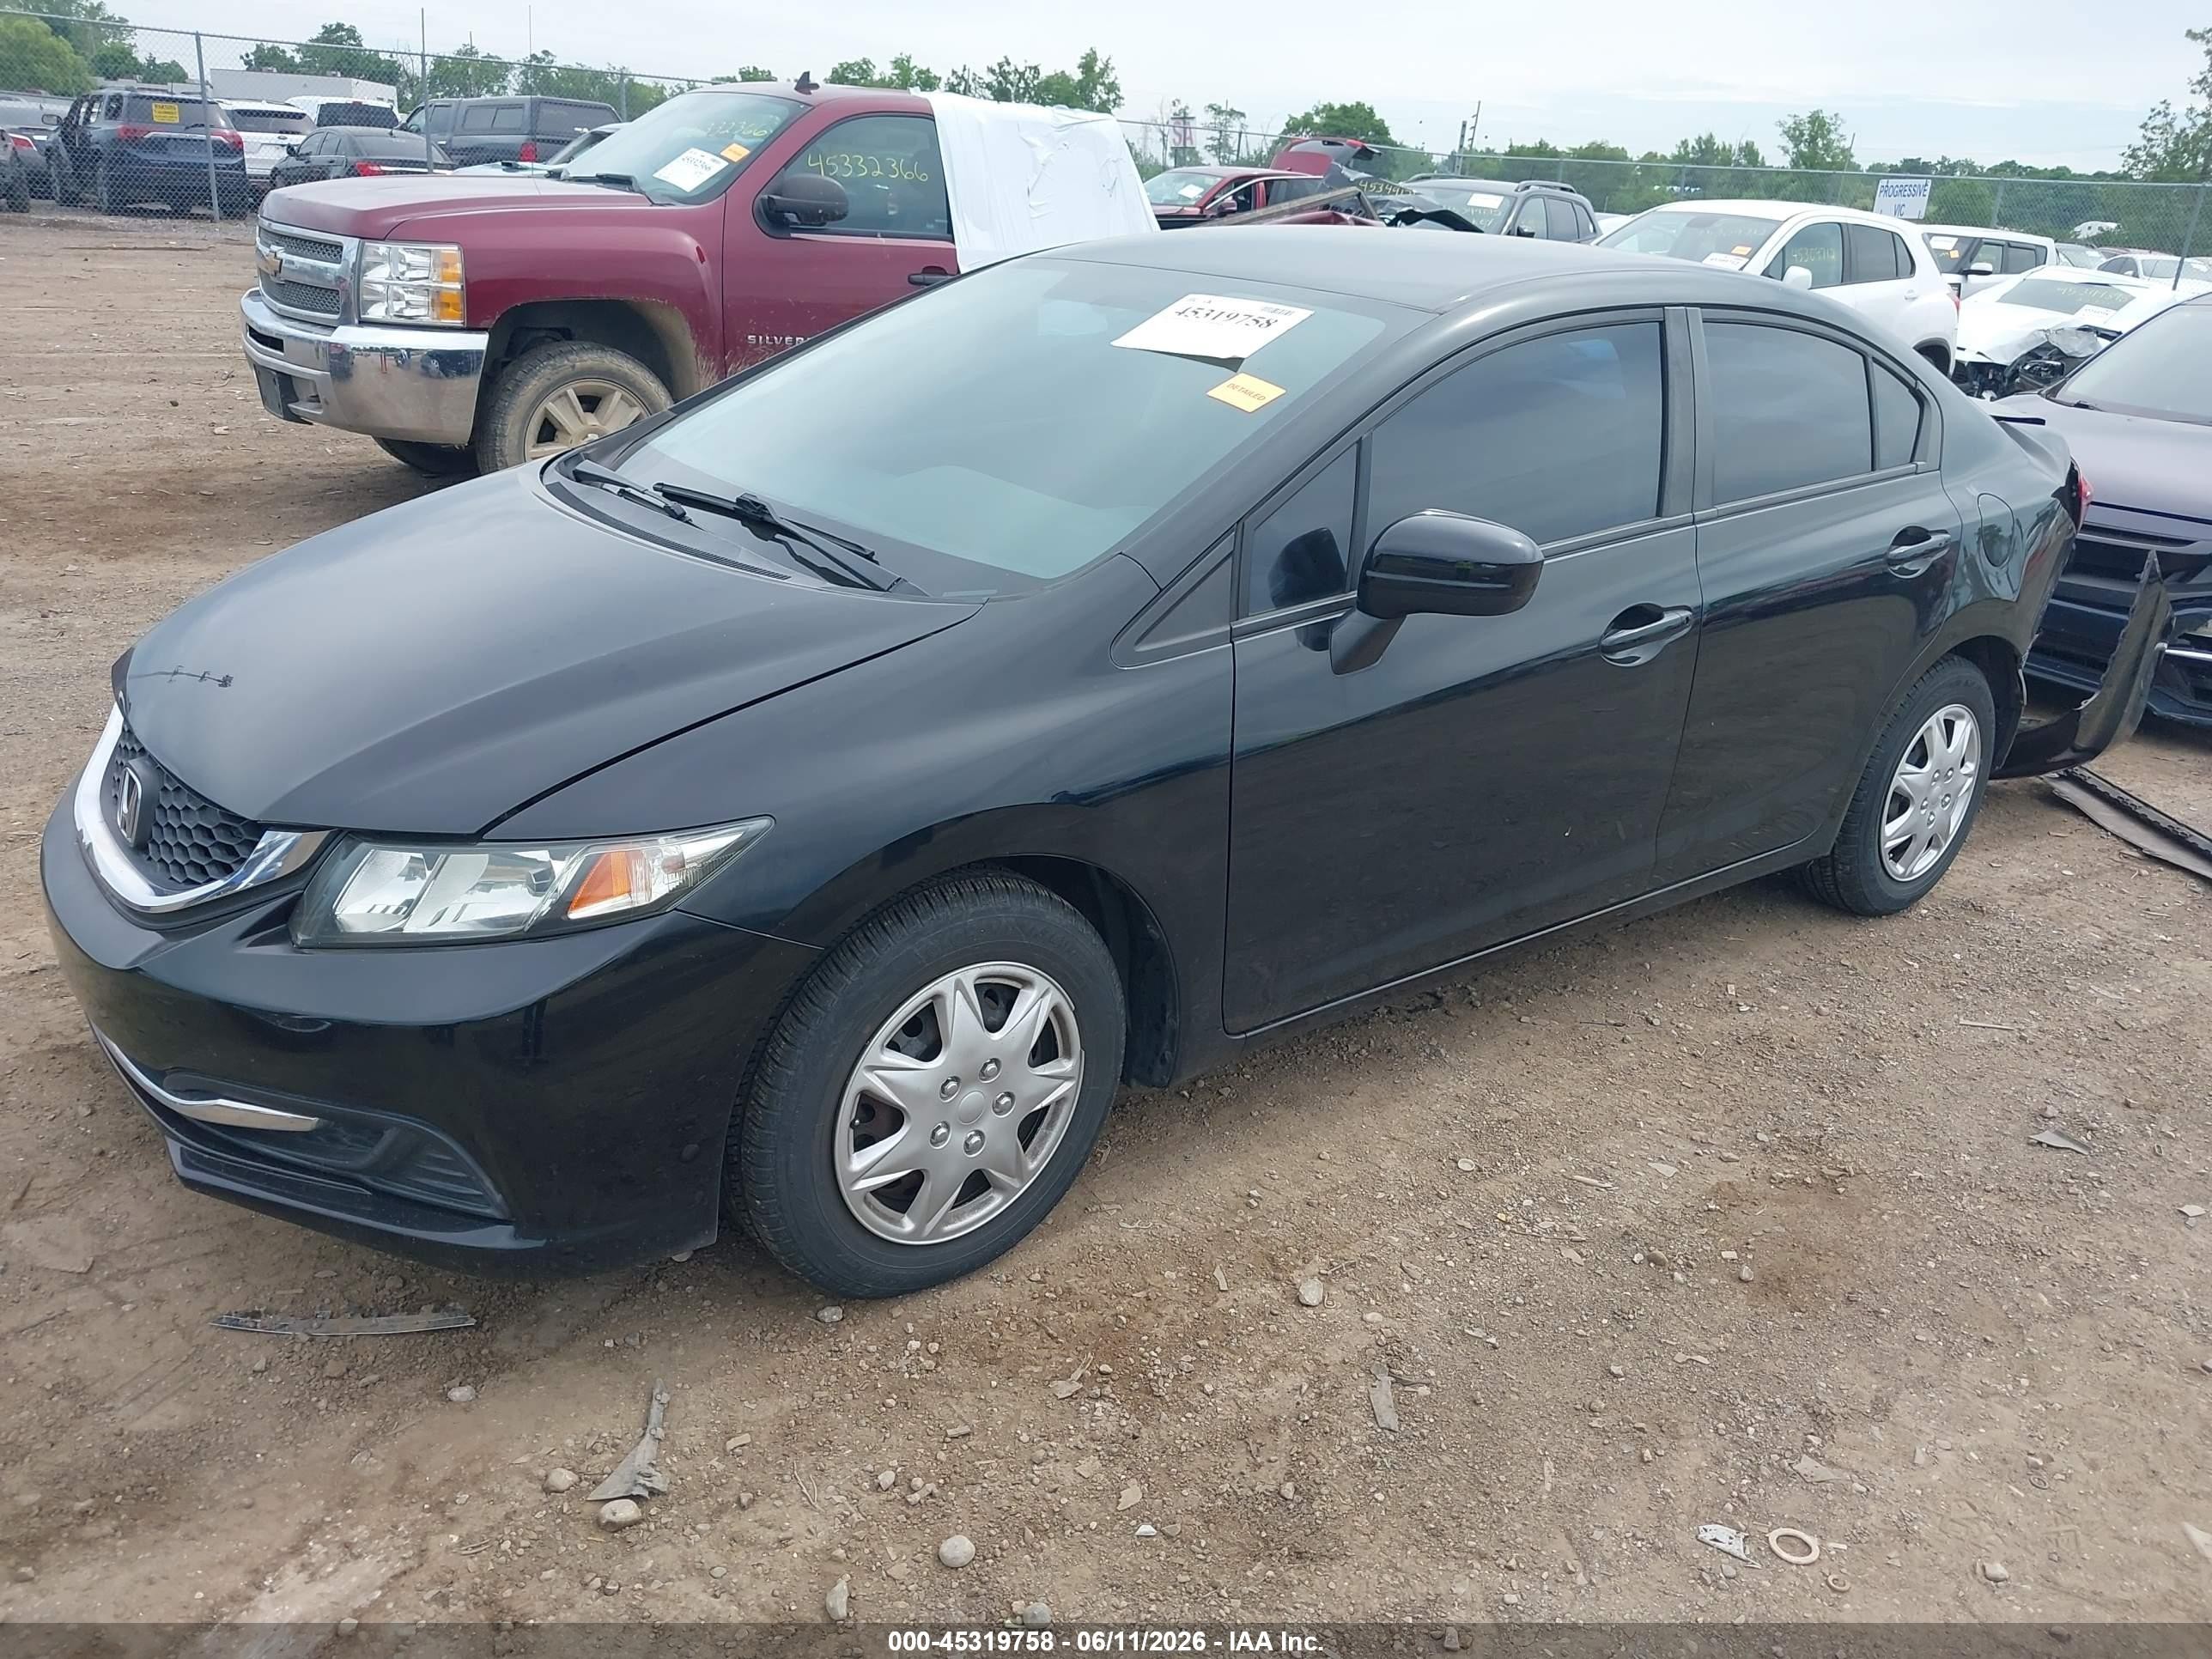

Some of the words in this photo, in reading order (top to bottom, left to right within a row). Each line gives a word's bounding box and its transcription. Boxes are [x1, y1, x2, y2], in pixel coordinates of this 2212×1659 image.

[807, 154, 928, 181] 45332366
[1879, 184, 1929, 198] PROGRESSIVE
[1893, 204, 1906, 216] VIC
[1175, 307, 1279, 329] 45319758
[747, 335, 811, 345] SILVER
[1226, 382, 1267, 401] DETAILED
